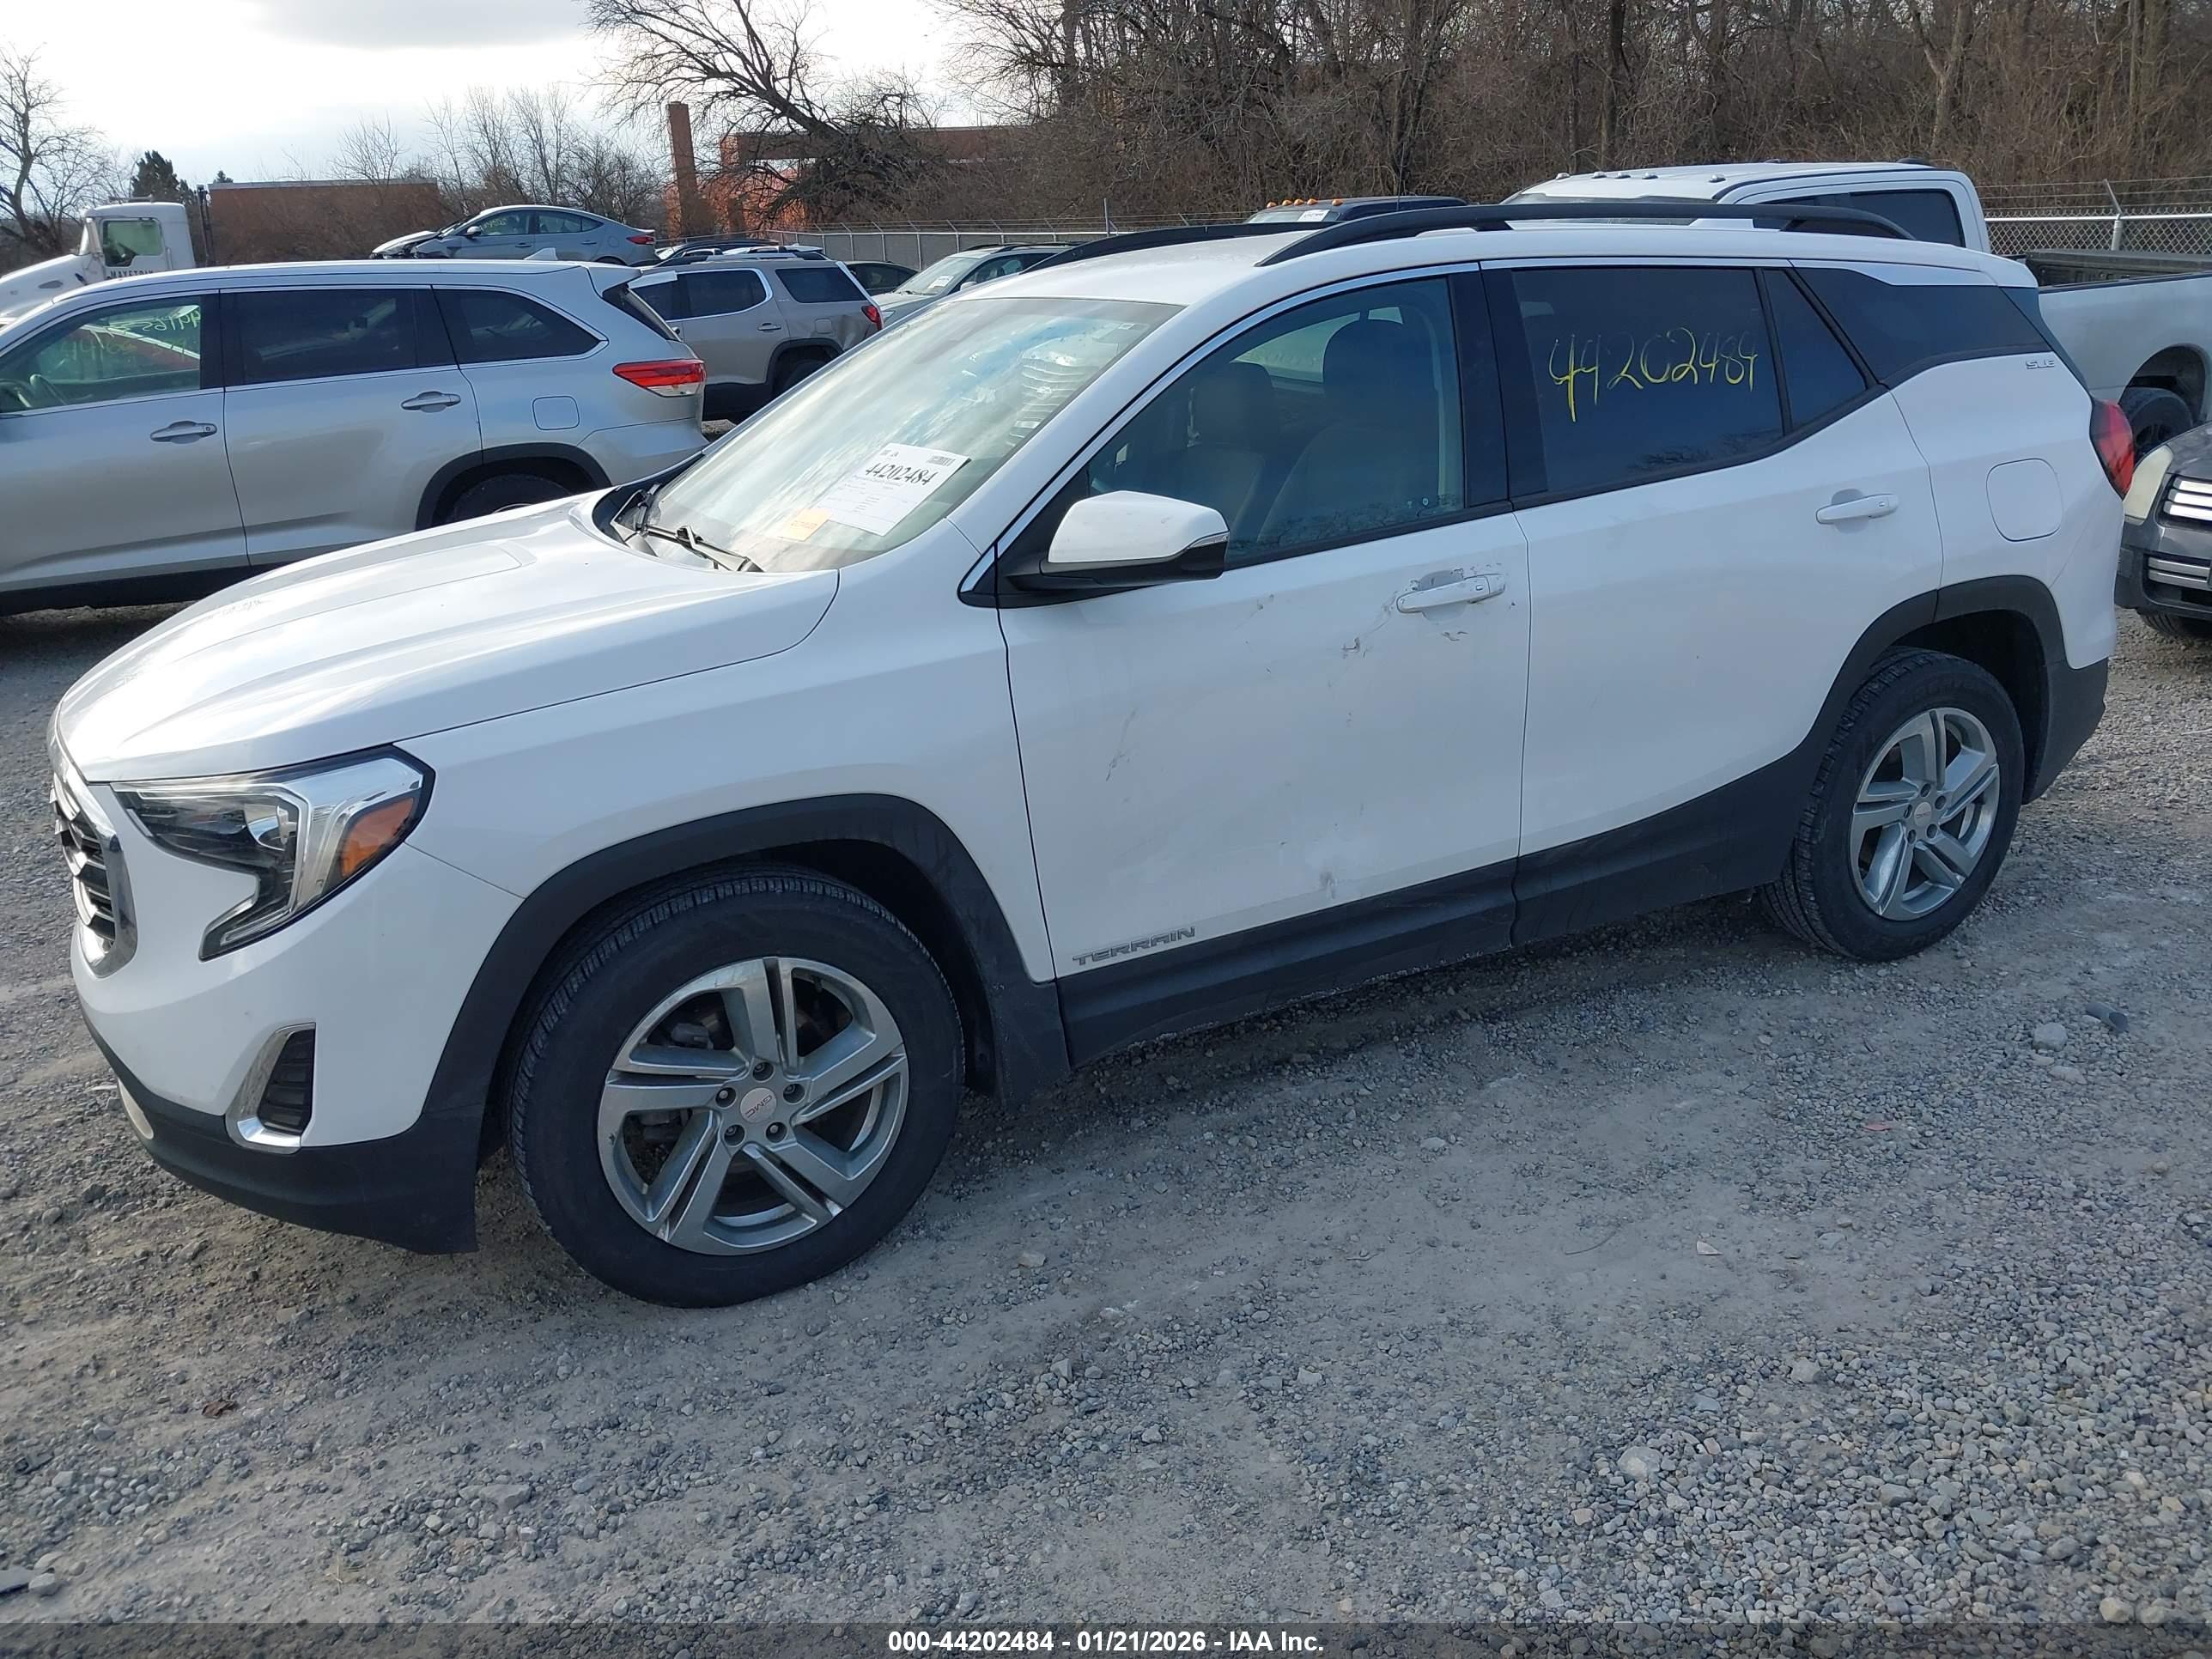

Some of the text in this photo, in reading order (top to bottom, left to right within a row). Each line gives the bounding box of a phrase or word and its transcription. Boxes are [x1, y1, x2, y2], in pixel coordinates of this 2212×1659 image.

[1548, 326, 1759, 422] 44202484
[2025, 360, 2055, 370] SLE
[865, 462, 939, 486] 44202484
[1073, 927, 1196, 966] TERRAIN
[745, 1094, 773, 1118] GMC
